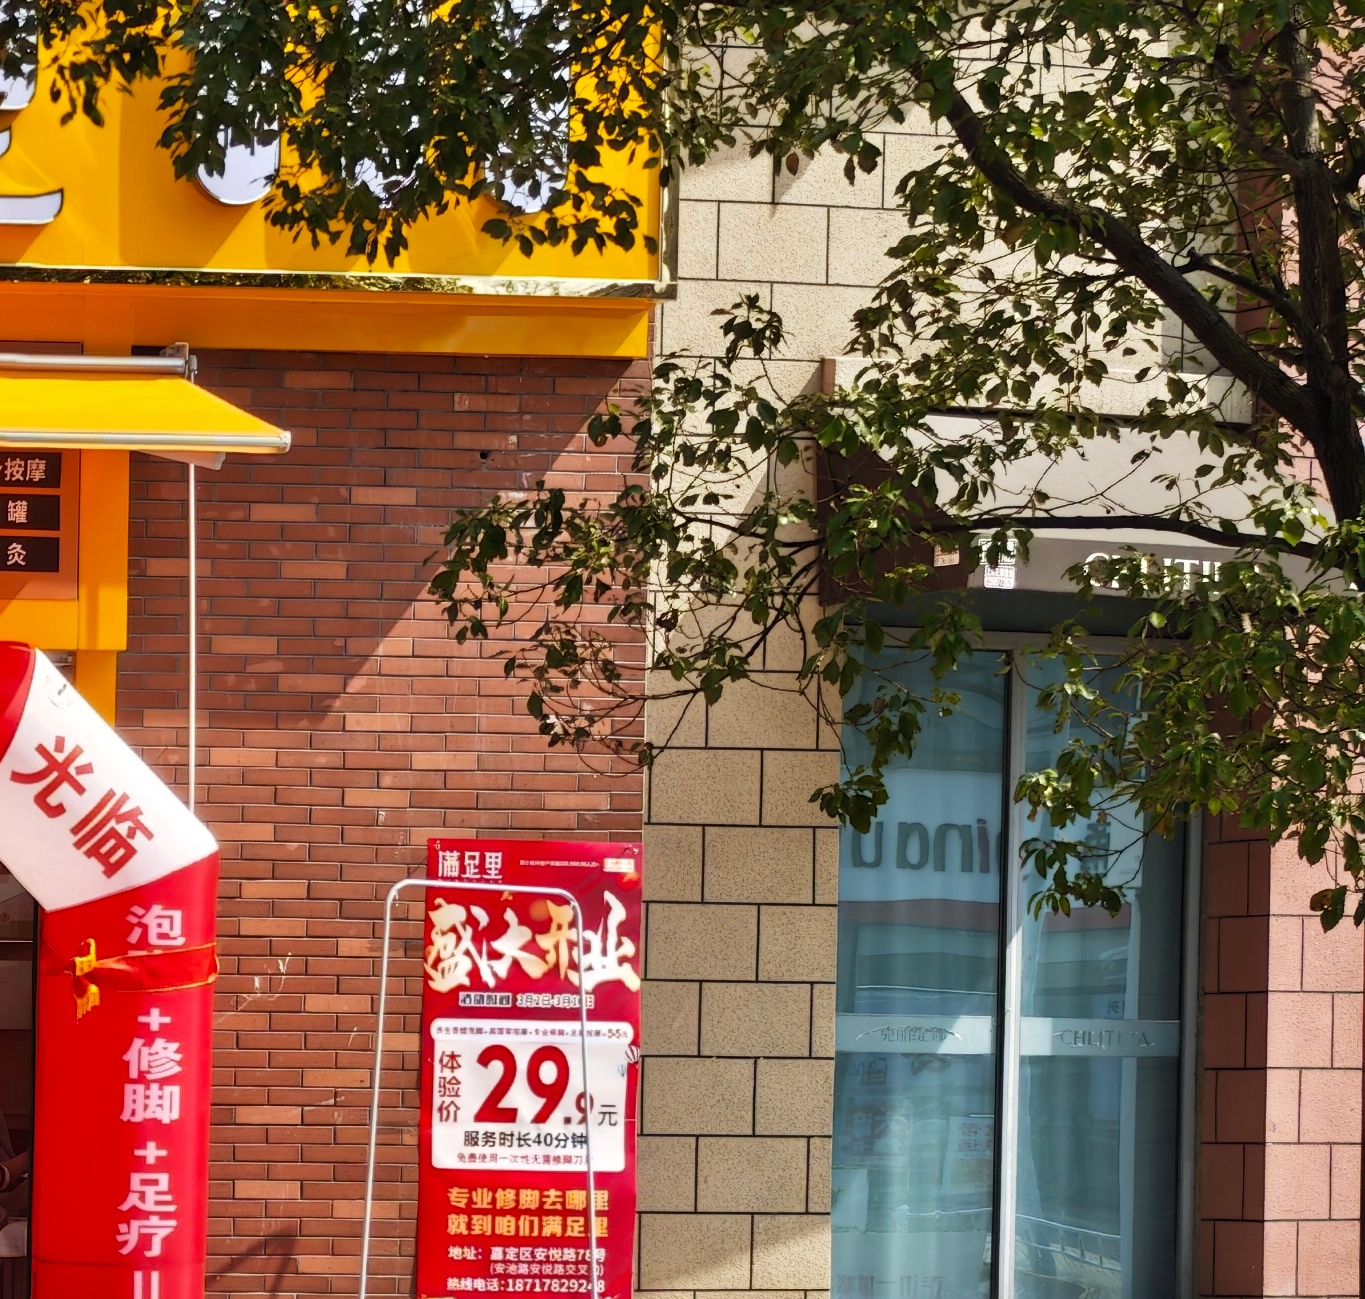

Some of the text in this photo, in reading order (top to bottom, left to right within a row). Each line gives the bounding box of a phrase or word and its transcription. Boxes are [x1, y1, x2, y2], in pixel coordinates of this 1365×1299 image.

[11, 735, 155, 880] 光临
[438, 851, 503, 879] 满足里
[437, 1051, 462, 1123] 体验价
[473, 1044, 619, 1126] 29.9 元
[463, 1130, 589, 1149] 服务时长40分钟
[447, 1187, 610, 1211] 专业修脚去哪里
[447, 1214, 609, 1238] 就到咱们满足里
